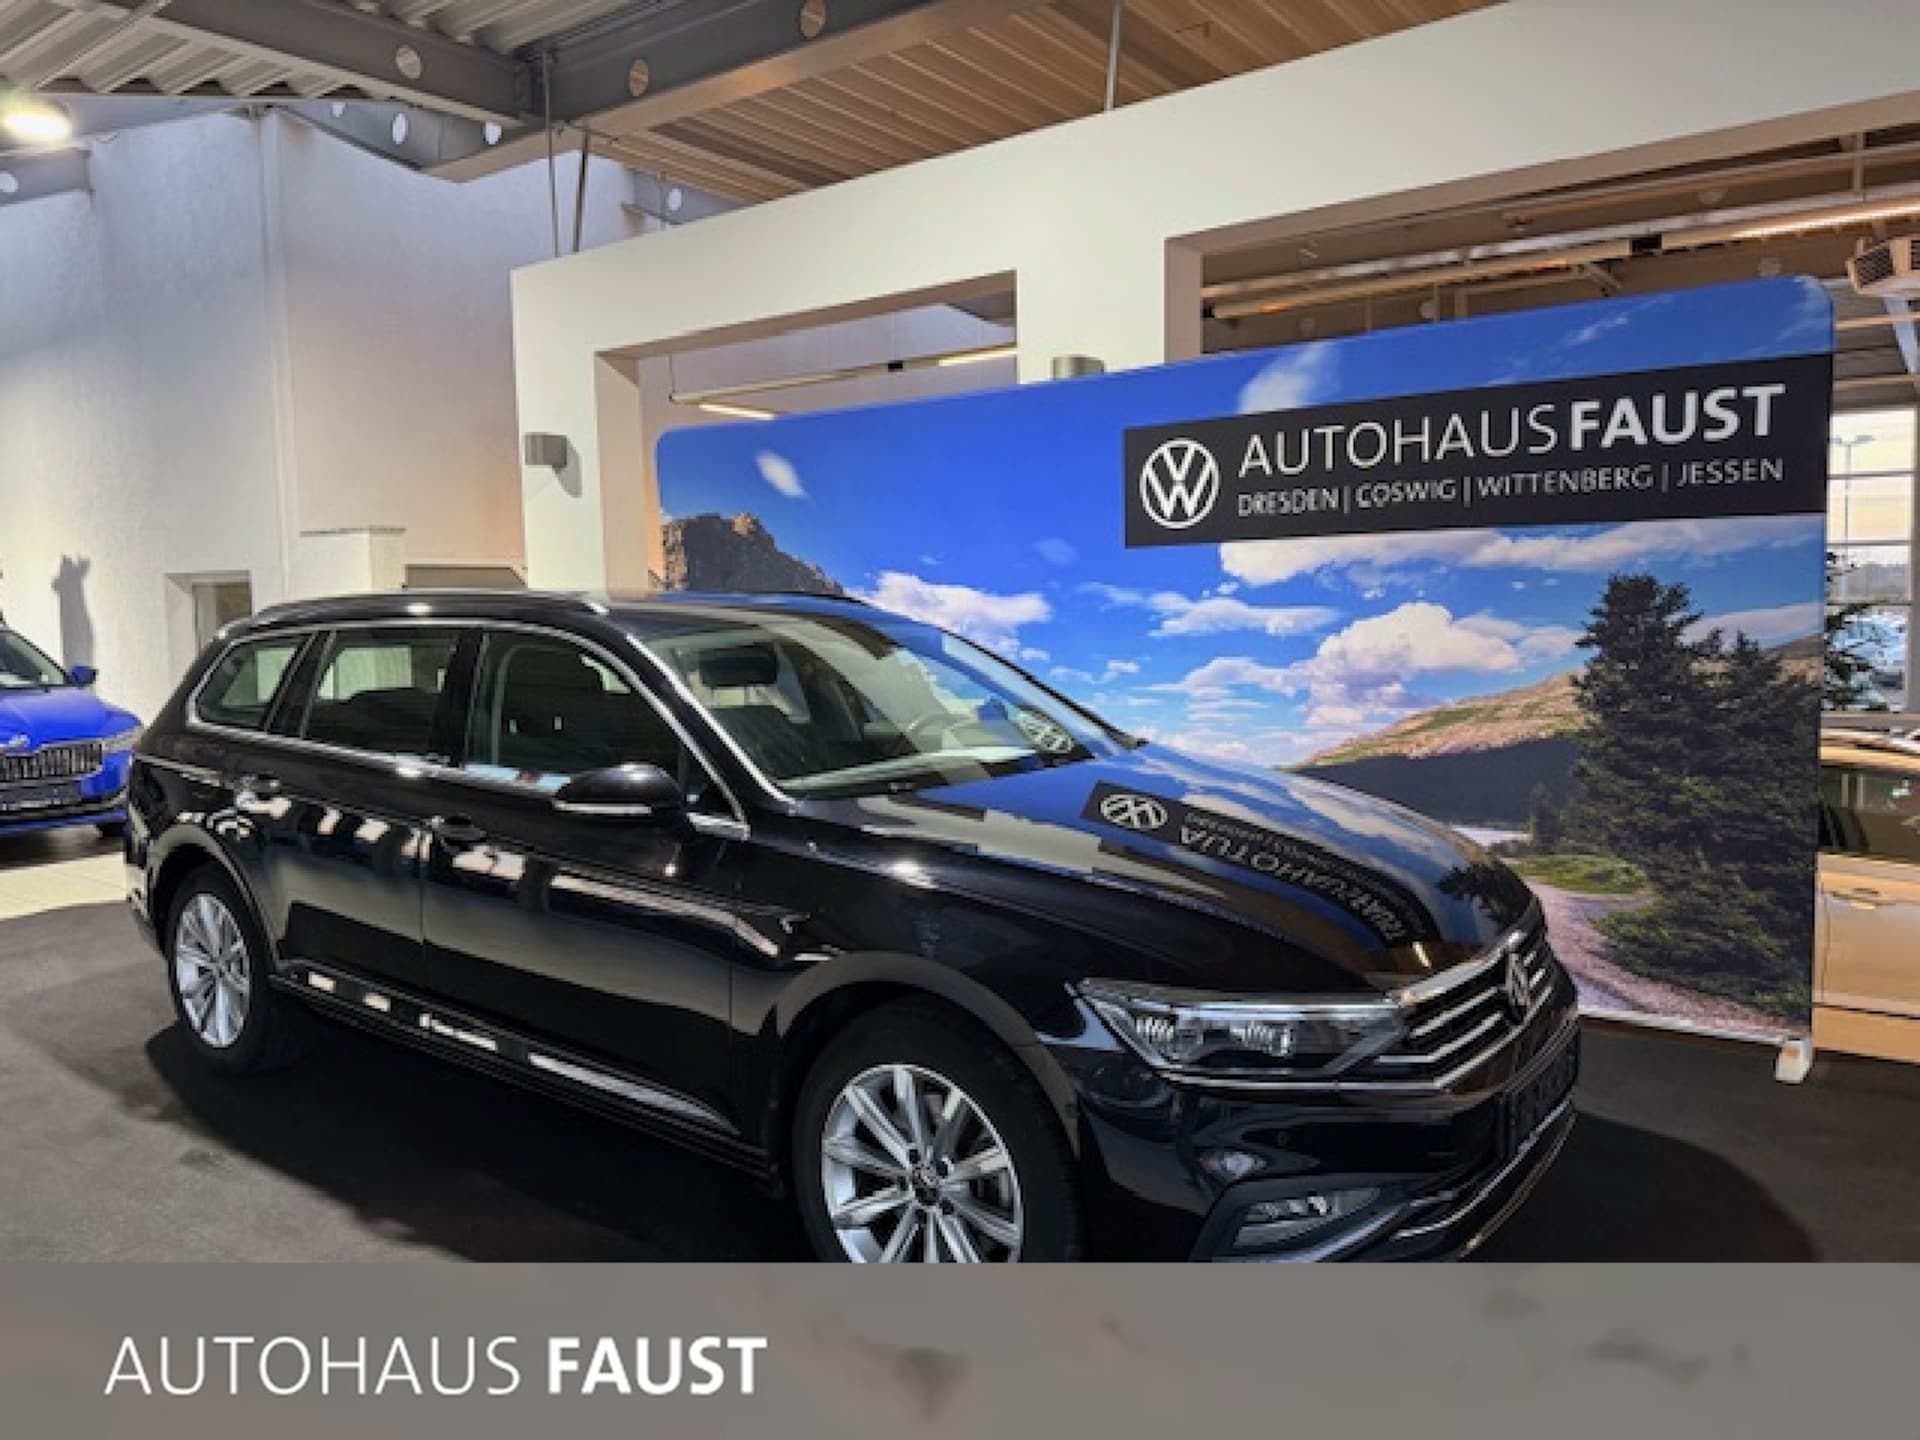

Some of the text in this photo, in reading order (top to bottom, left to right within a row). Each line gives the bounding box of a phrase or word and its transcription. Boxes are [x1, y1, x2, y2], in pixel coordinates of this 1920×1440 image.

[1238, 383, 1786, 477] AUTOHAUS FAUST
[1237, 458, 1783, 517] DRESDEN COSWIG WITTENBERG JESSEN
